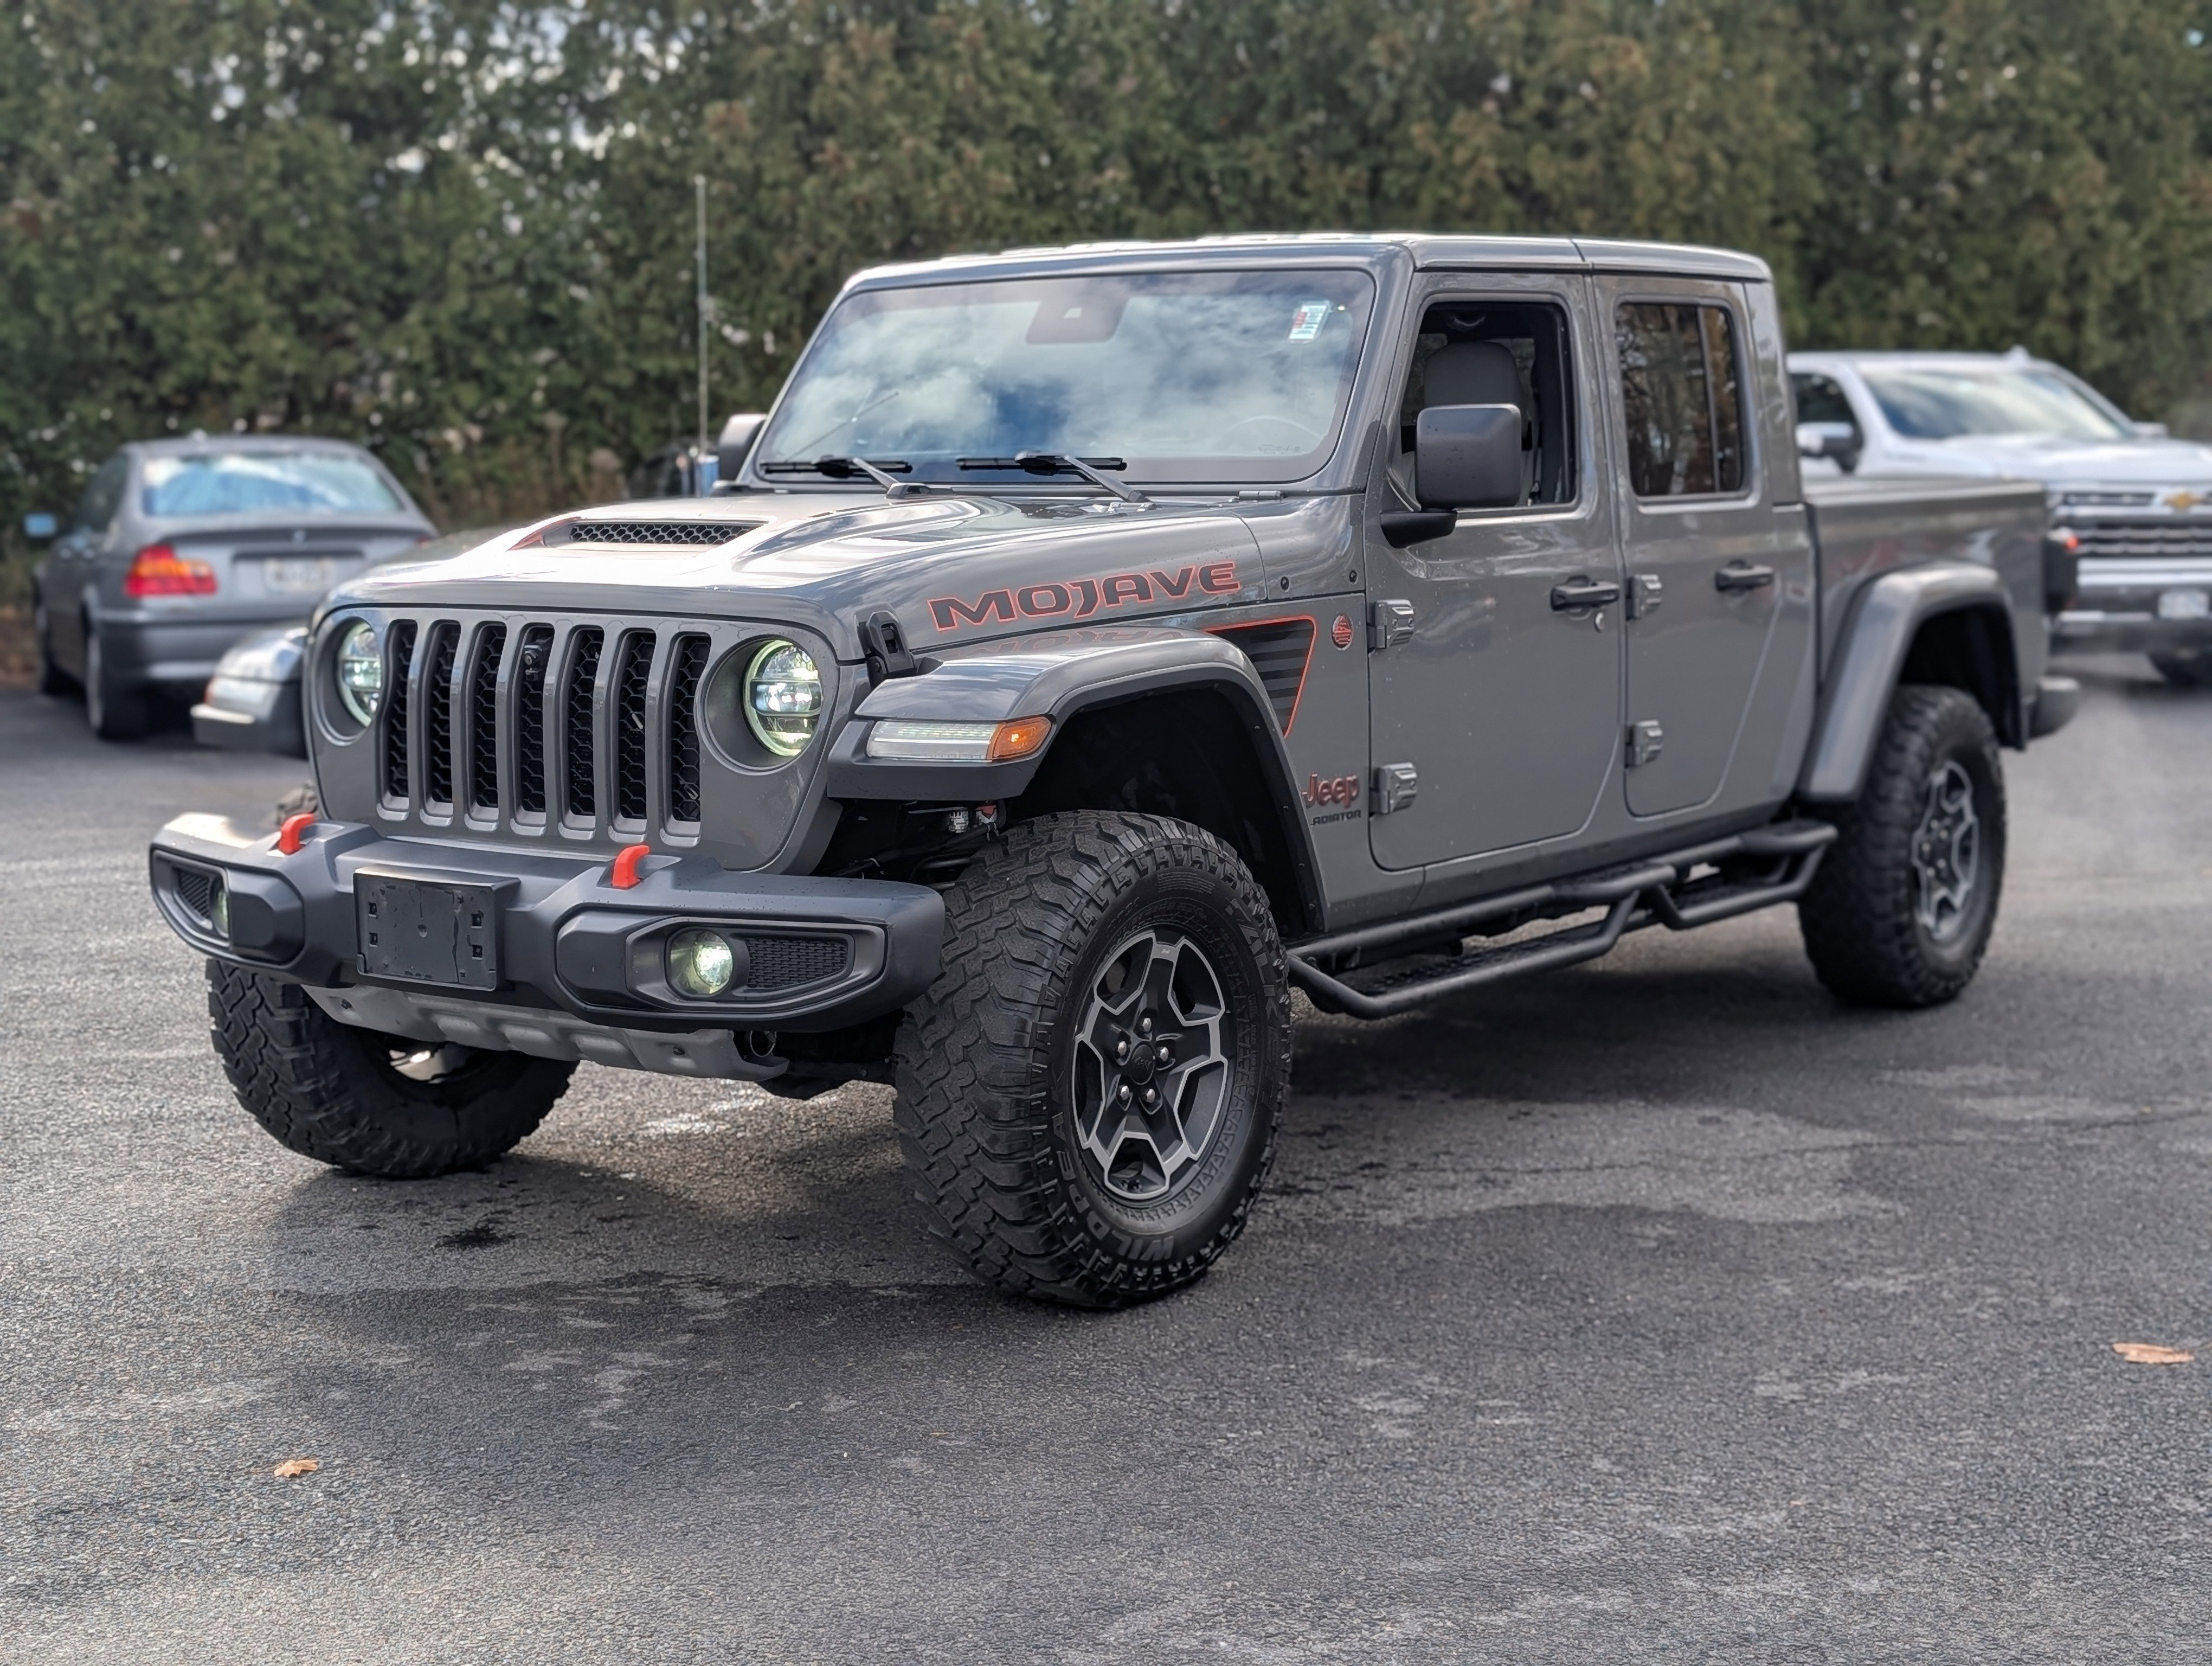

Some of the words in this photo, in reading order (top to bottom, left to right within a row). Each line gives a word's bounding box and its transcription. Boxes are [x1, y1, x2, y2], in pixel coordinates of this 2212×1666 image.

[927, 561, 1242, 631] MOJAVE
[1301, 772, 1360, 809] Jeep
[1311, 810, 1361, 825] ADIATOR
